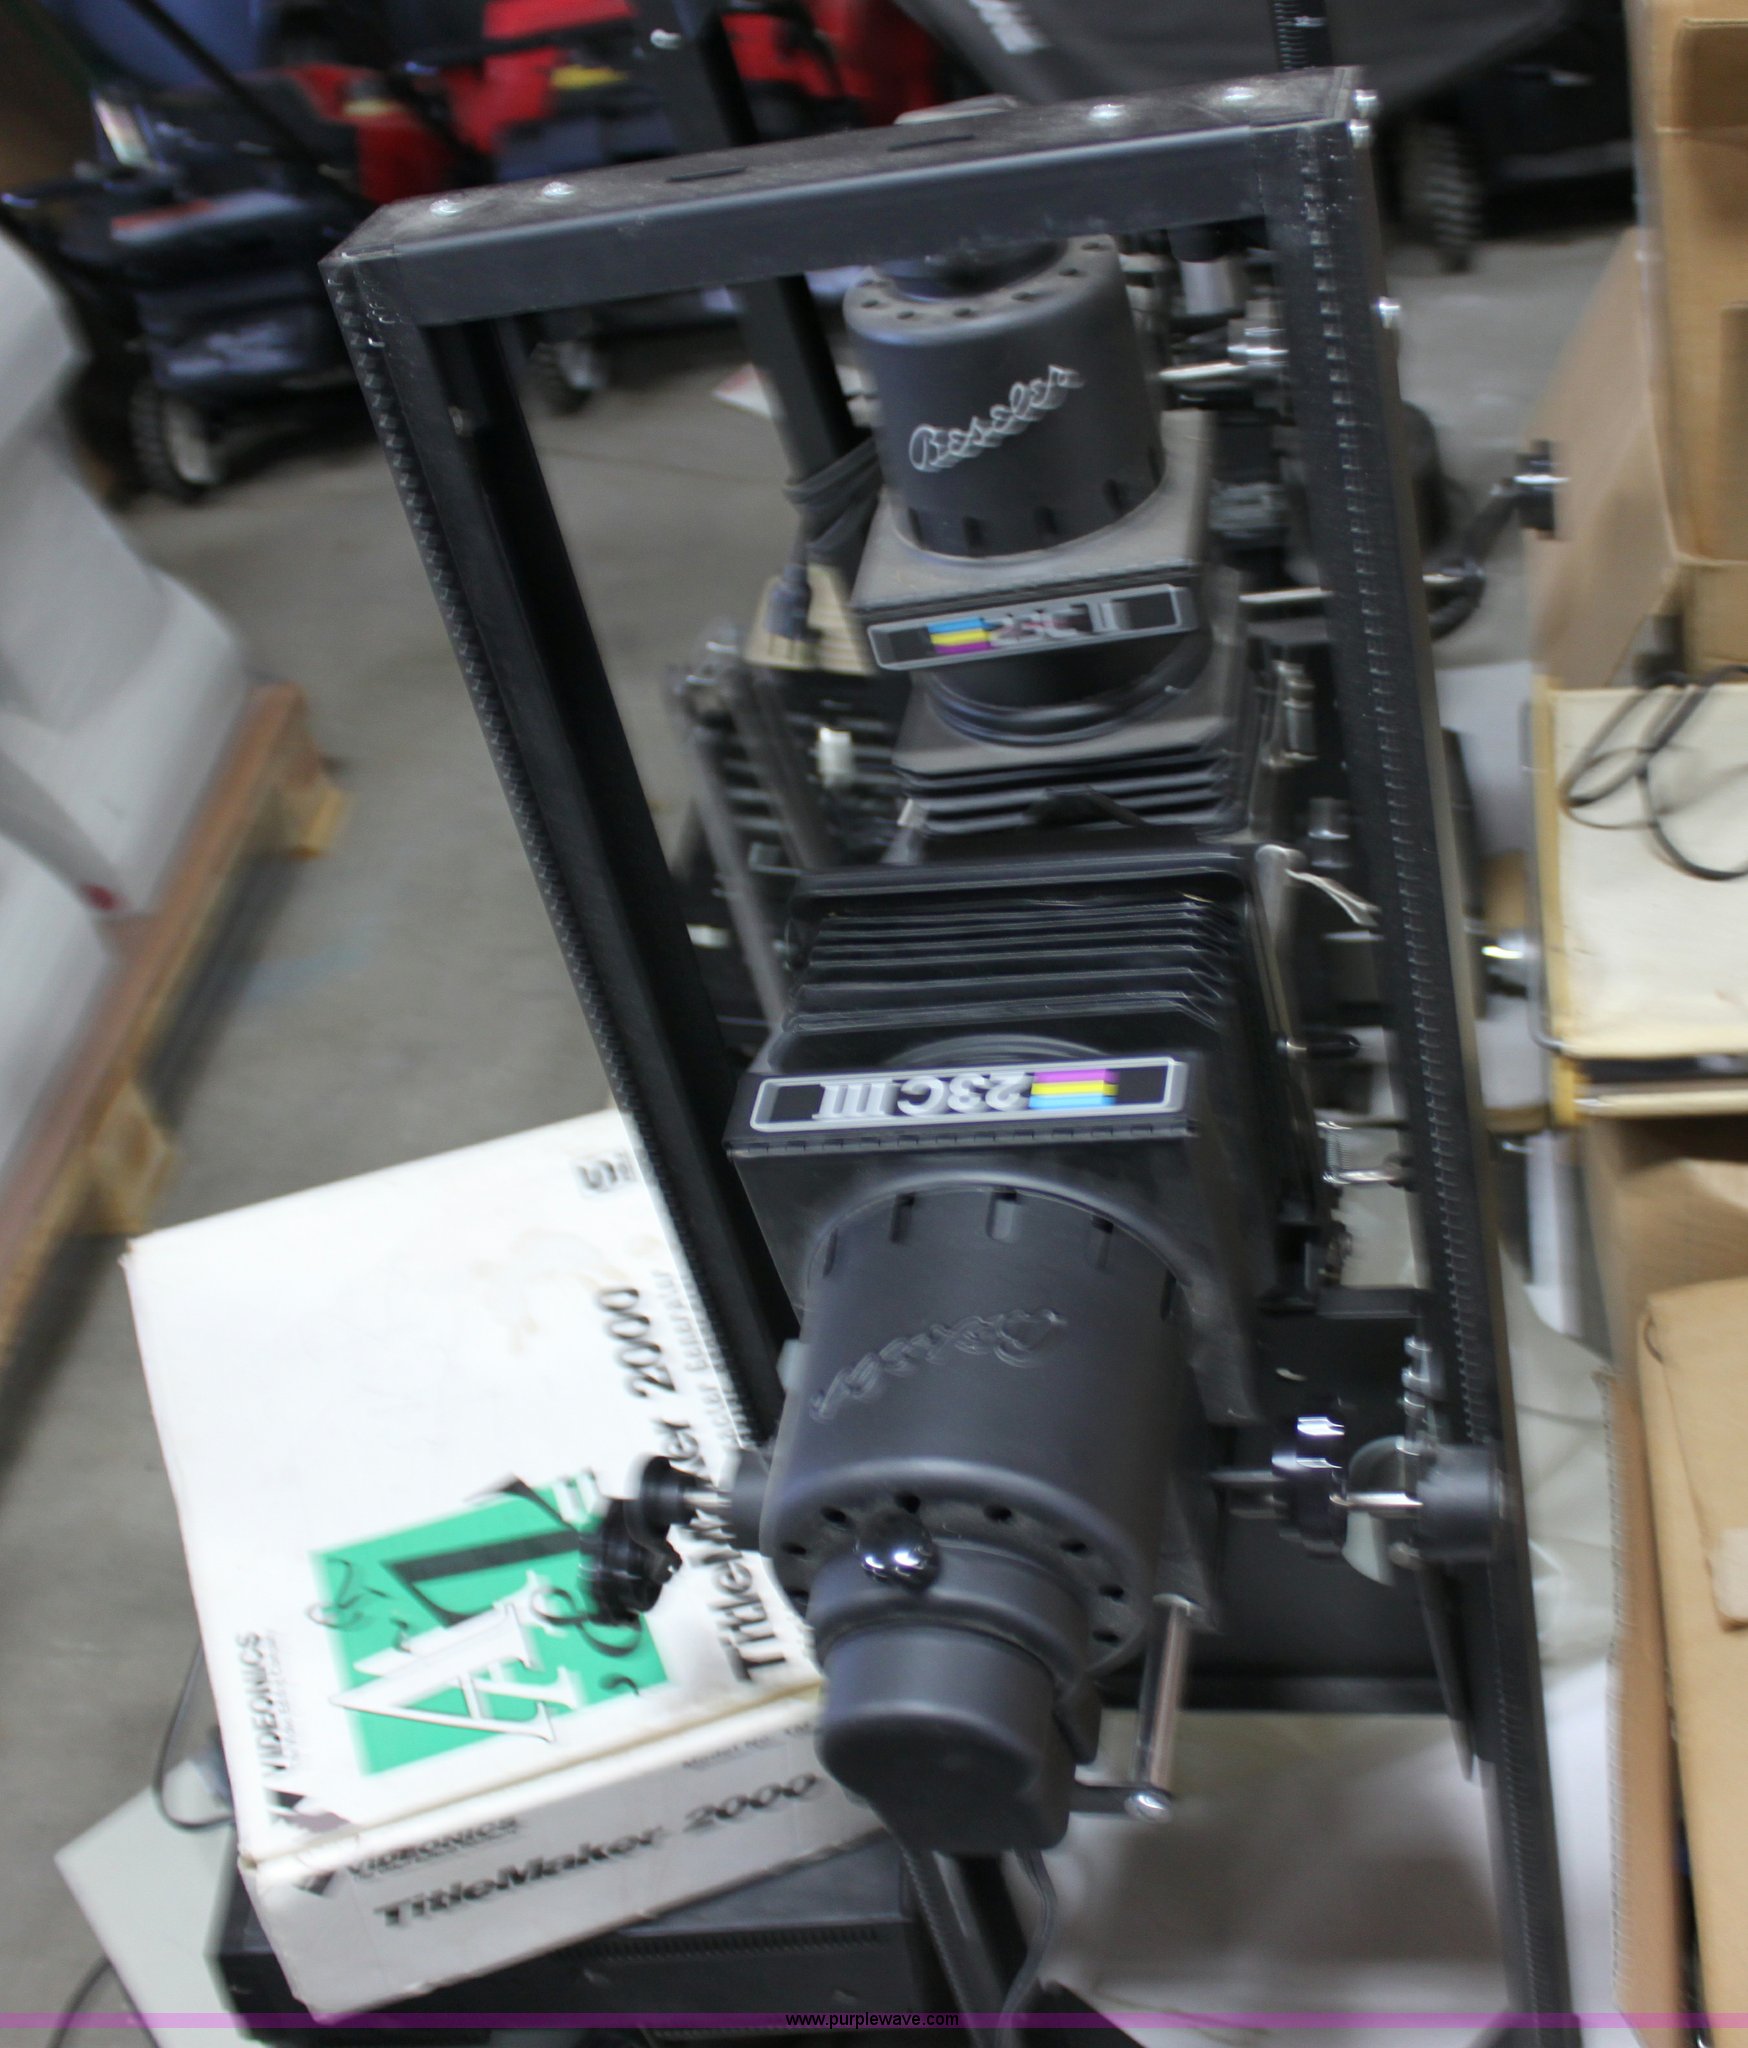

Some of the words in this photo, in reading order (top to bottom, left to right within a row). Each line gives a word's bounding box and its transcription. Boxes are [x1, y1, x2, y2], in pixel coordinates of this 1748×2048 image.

[597, 1287, 677, 1398] 2000
[373, 1824, 668, 1927] TitleMaker
[683, 1772, 820, 1833] 2000
